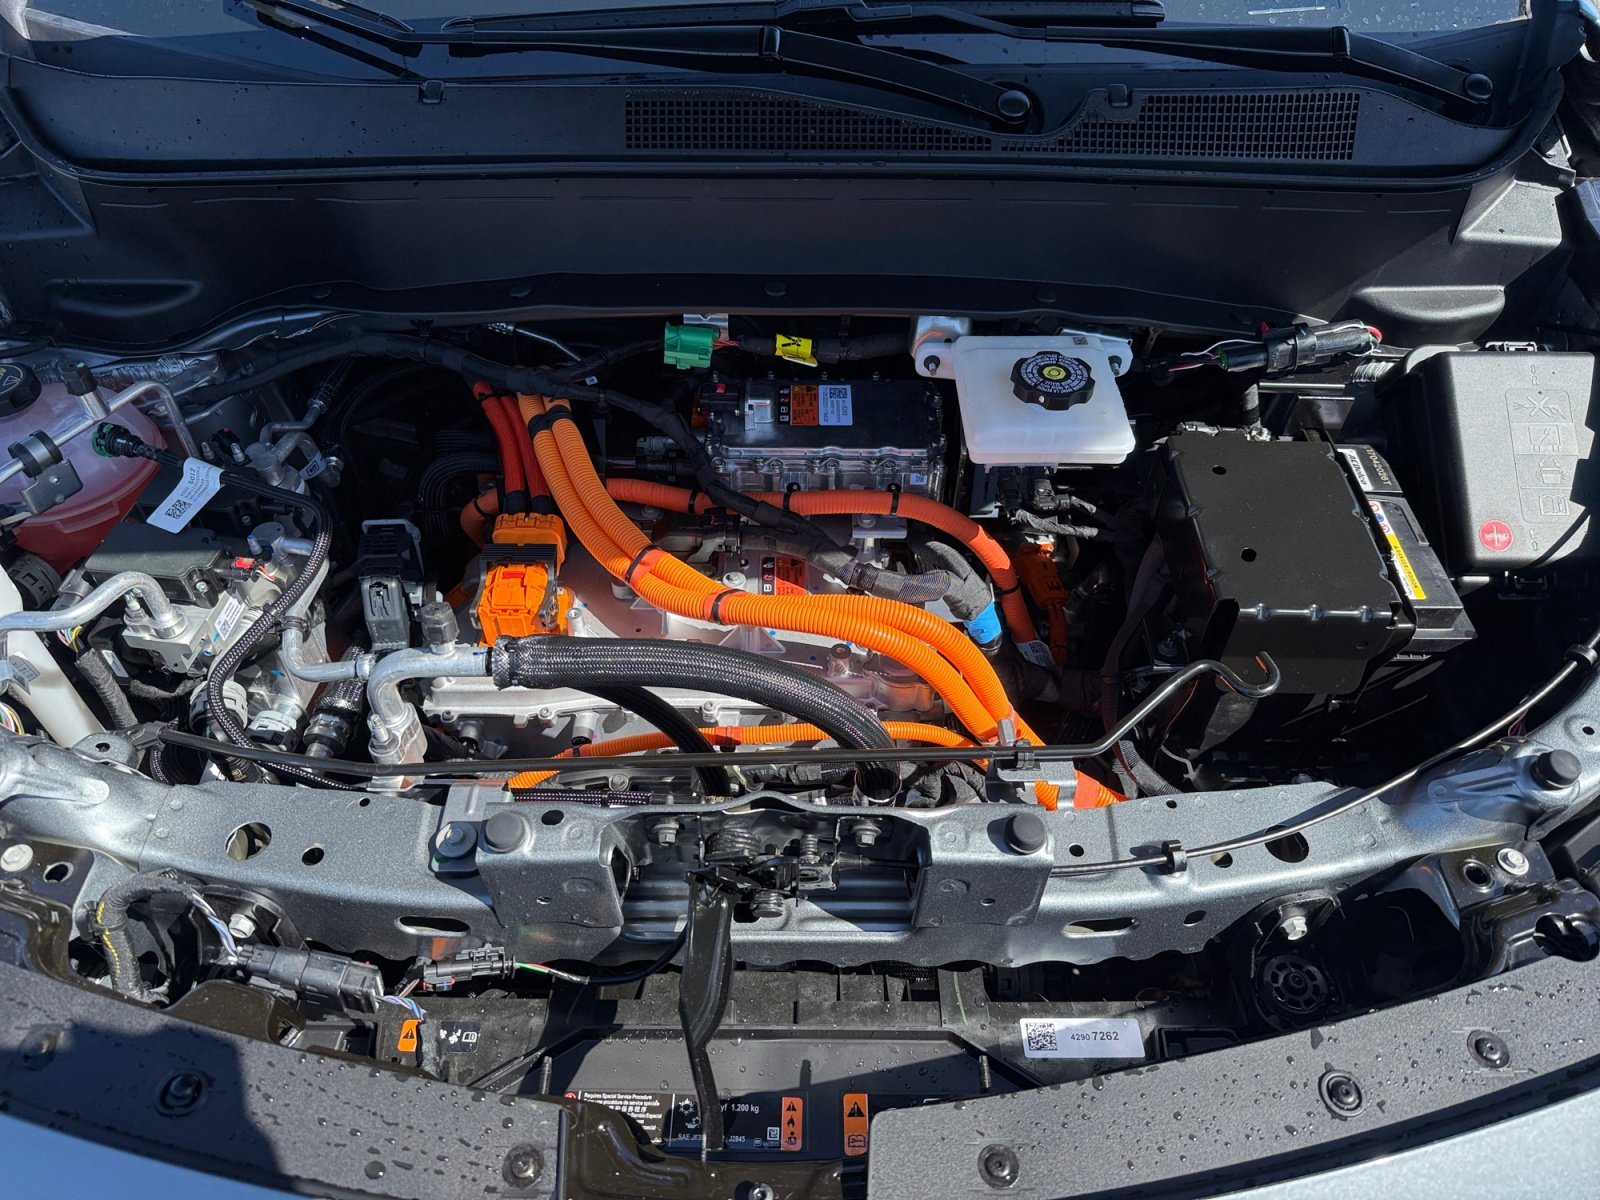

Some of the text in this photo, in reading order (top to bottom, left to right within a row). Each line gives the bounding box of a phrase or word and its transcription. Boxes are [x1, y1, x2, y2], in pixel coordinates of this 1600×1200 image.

[1348, 452, 1368, 486] ACDelco
[1070, 1031, 1120, 1041] 4290 7262
[583, 1092, 602, 1100] Requires
[602, 1092, 617, 1100] Special
[731, 1103, 749, 1112] 1.200
[750, 1104, 760, 1114] kg
[677, 1133, 691, 1141] SAE
[728, 1135, 746, 1143] J2845
